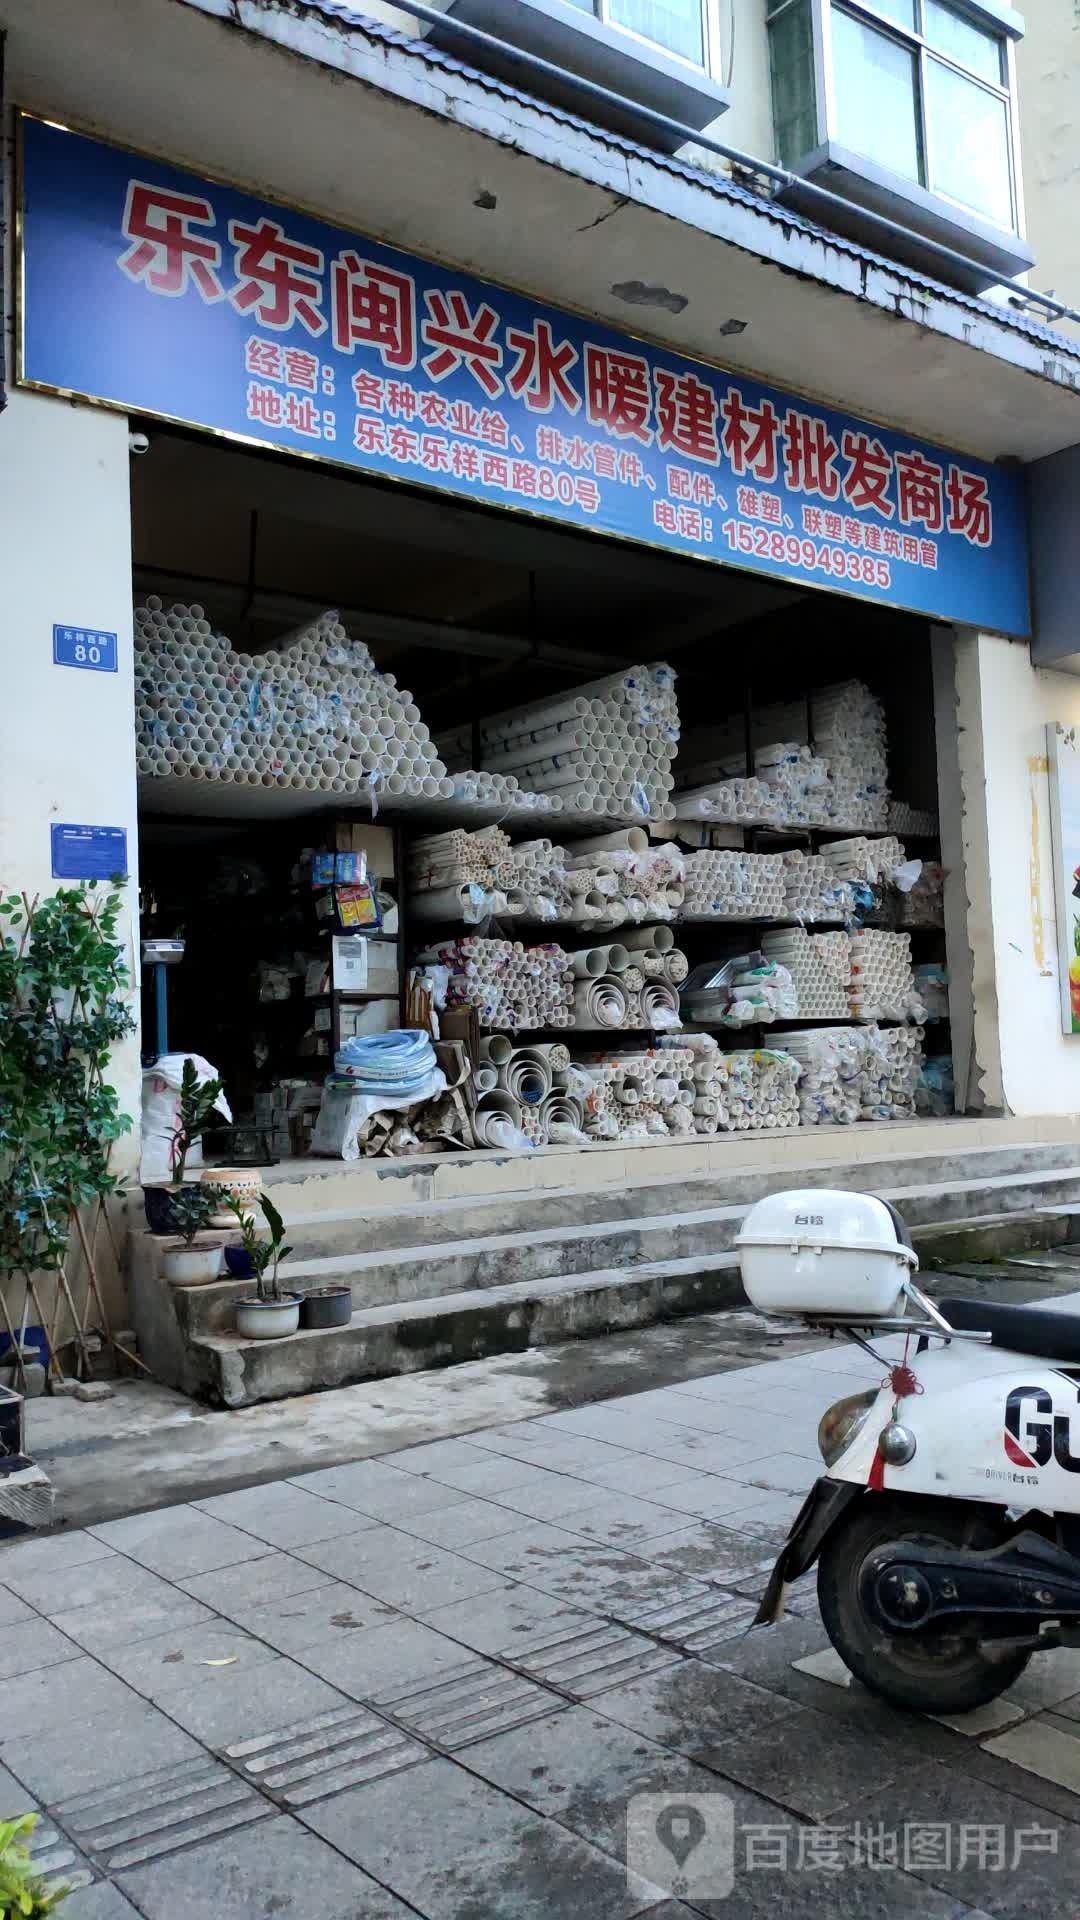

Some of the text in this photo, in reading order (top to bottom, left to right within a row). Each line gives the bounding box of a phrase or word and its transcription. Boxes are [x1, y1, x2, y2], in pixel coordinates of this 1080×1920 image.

[118, 180, 992, 547] 乐东闽兴水暖建材批发商场
[75, 644, 101, 663] 80
